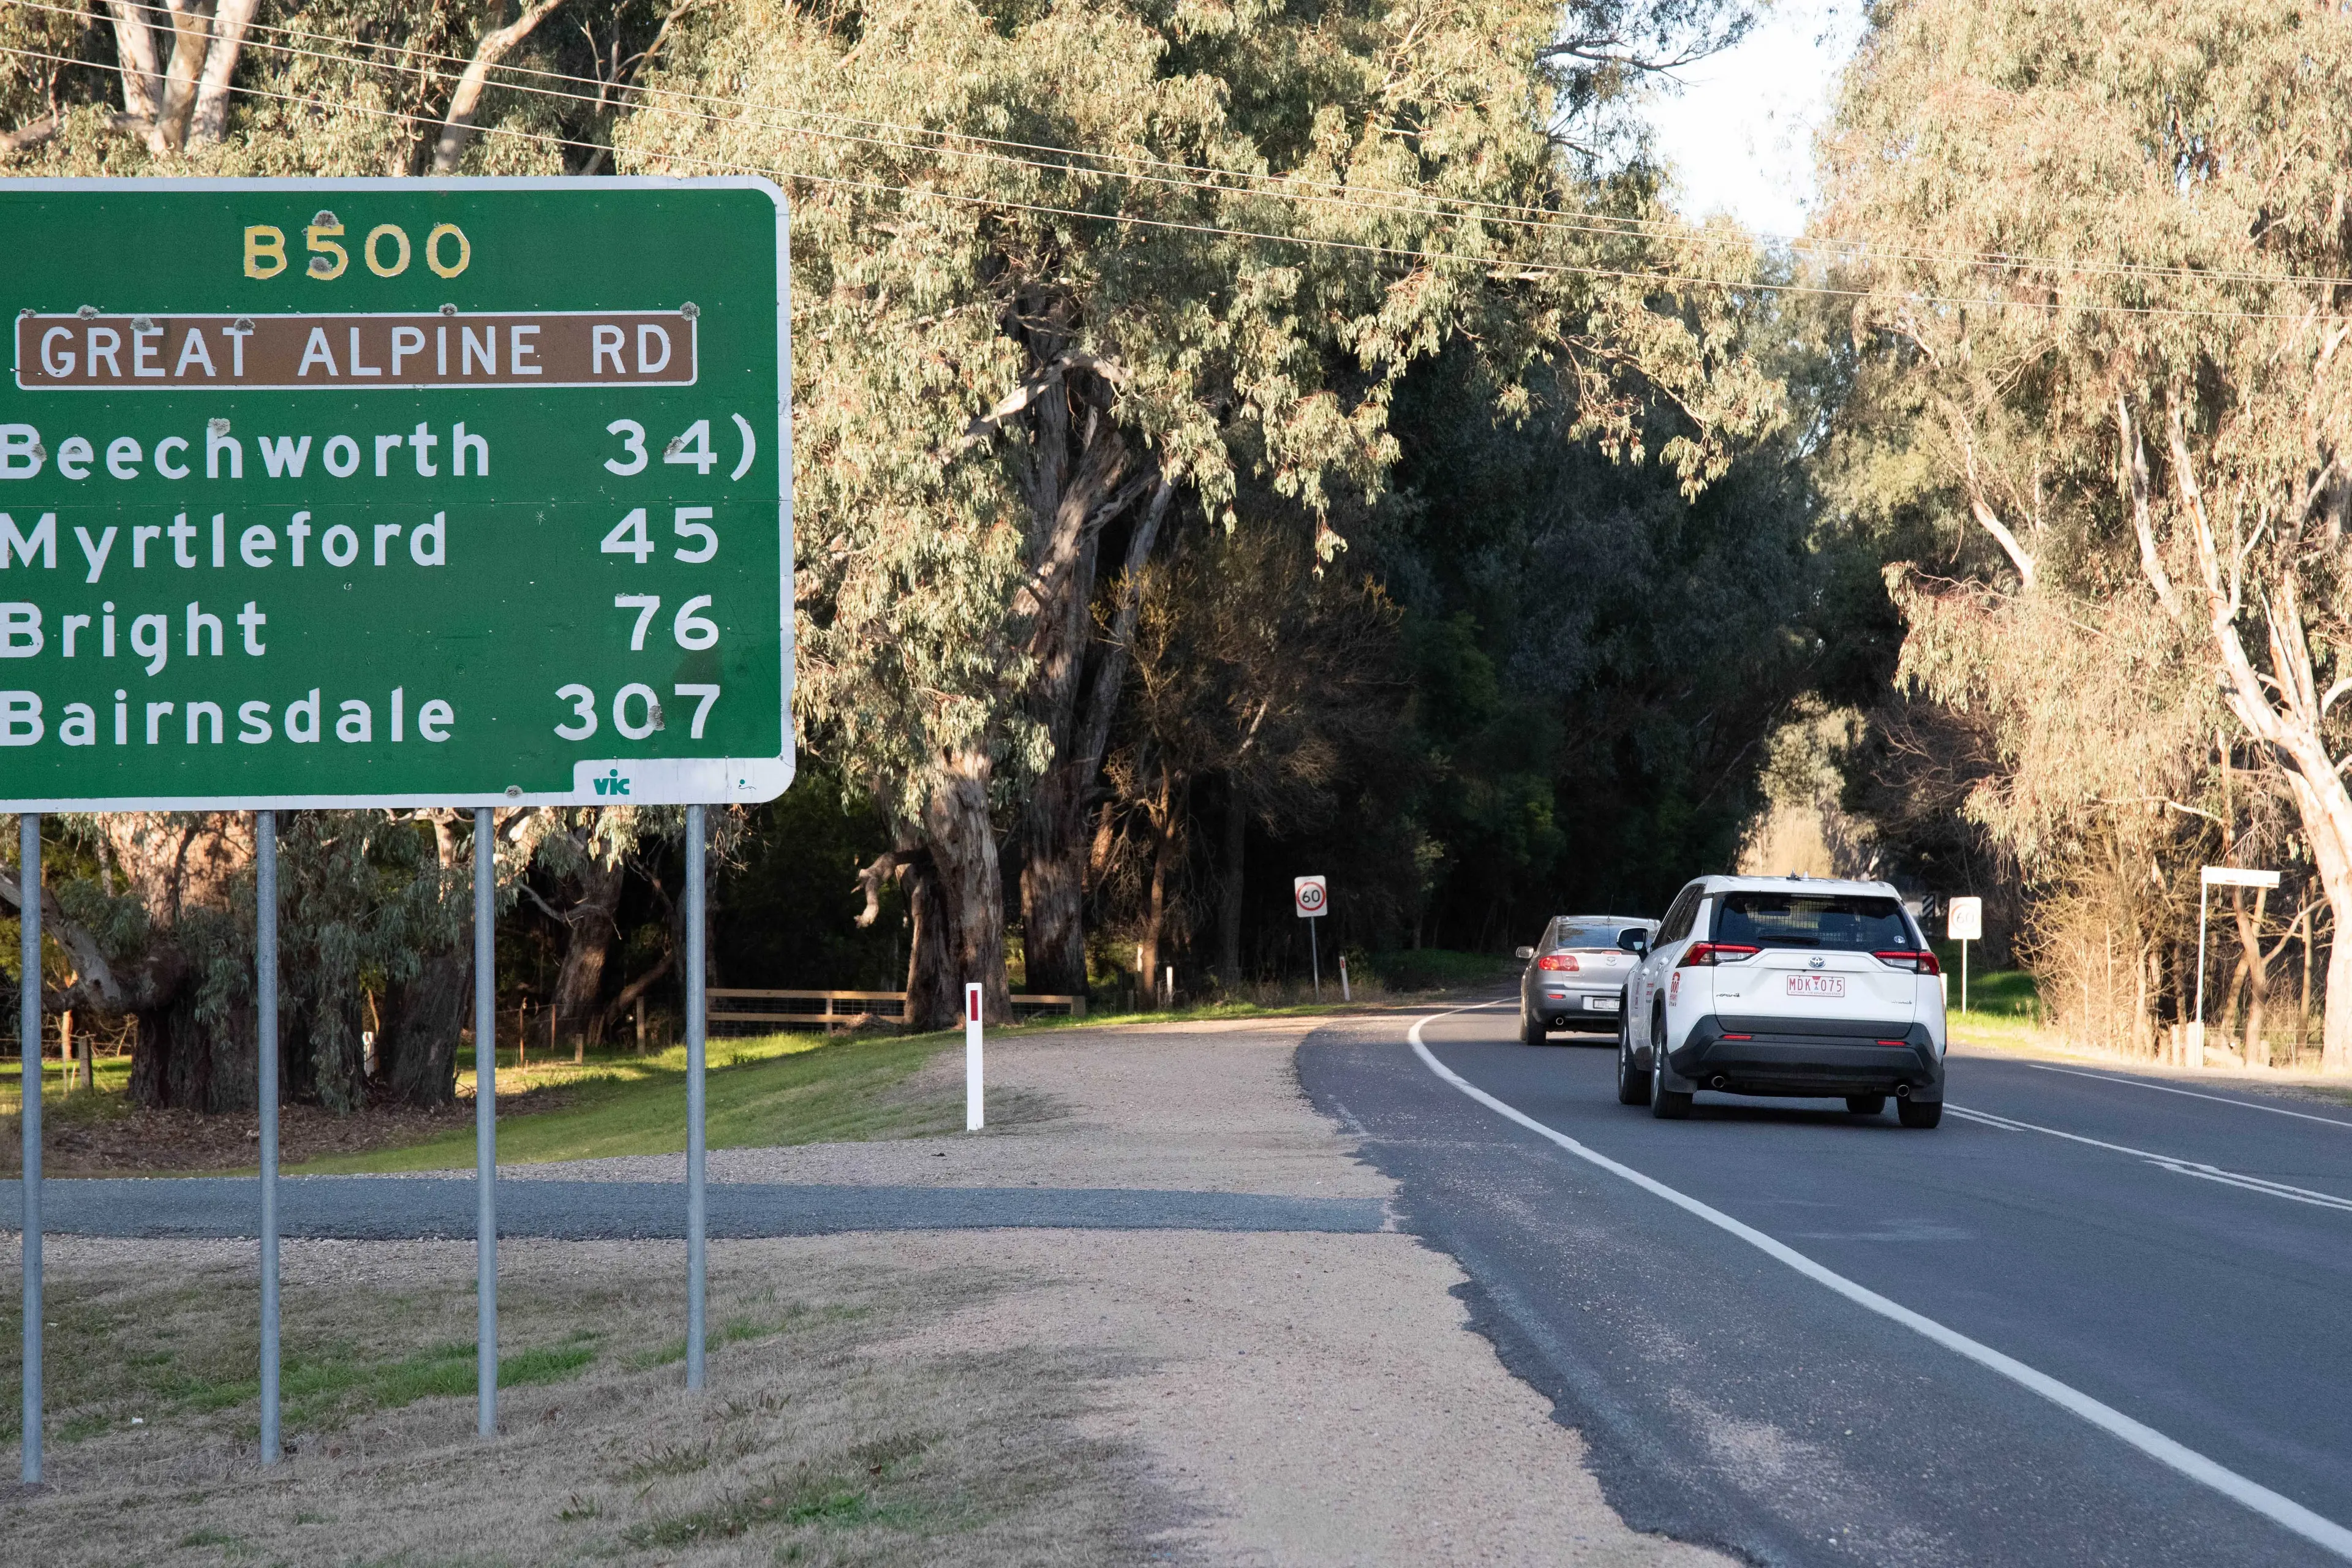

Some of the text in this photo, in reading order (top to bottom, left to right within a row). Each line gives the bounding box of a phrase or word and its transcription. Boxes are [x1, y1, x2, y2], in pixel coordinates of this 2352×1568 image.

[244, 223, 470, 281] B500
[41, 324, 671, 378] GREAT ALPINE RD
[0, 420, 489, 480] Beechworth
[0, 507, 718, 583] Myrtleford 45
[0, 594, 719, 677] Bright 76
[0, 683, 720, 746] Bairnsdale 307
[1303, 890, 1320, 903] 60
[1957, 912, 1974, 924] 60
[1789, 978, 1842, 992] MDK 075
